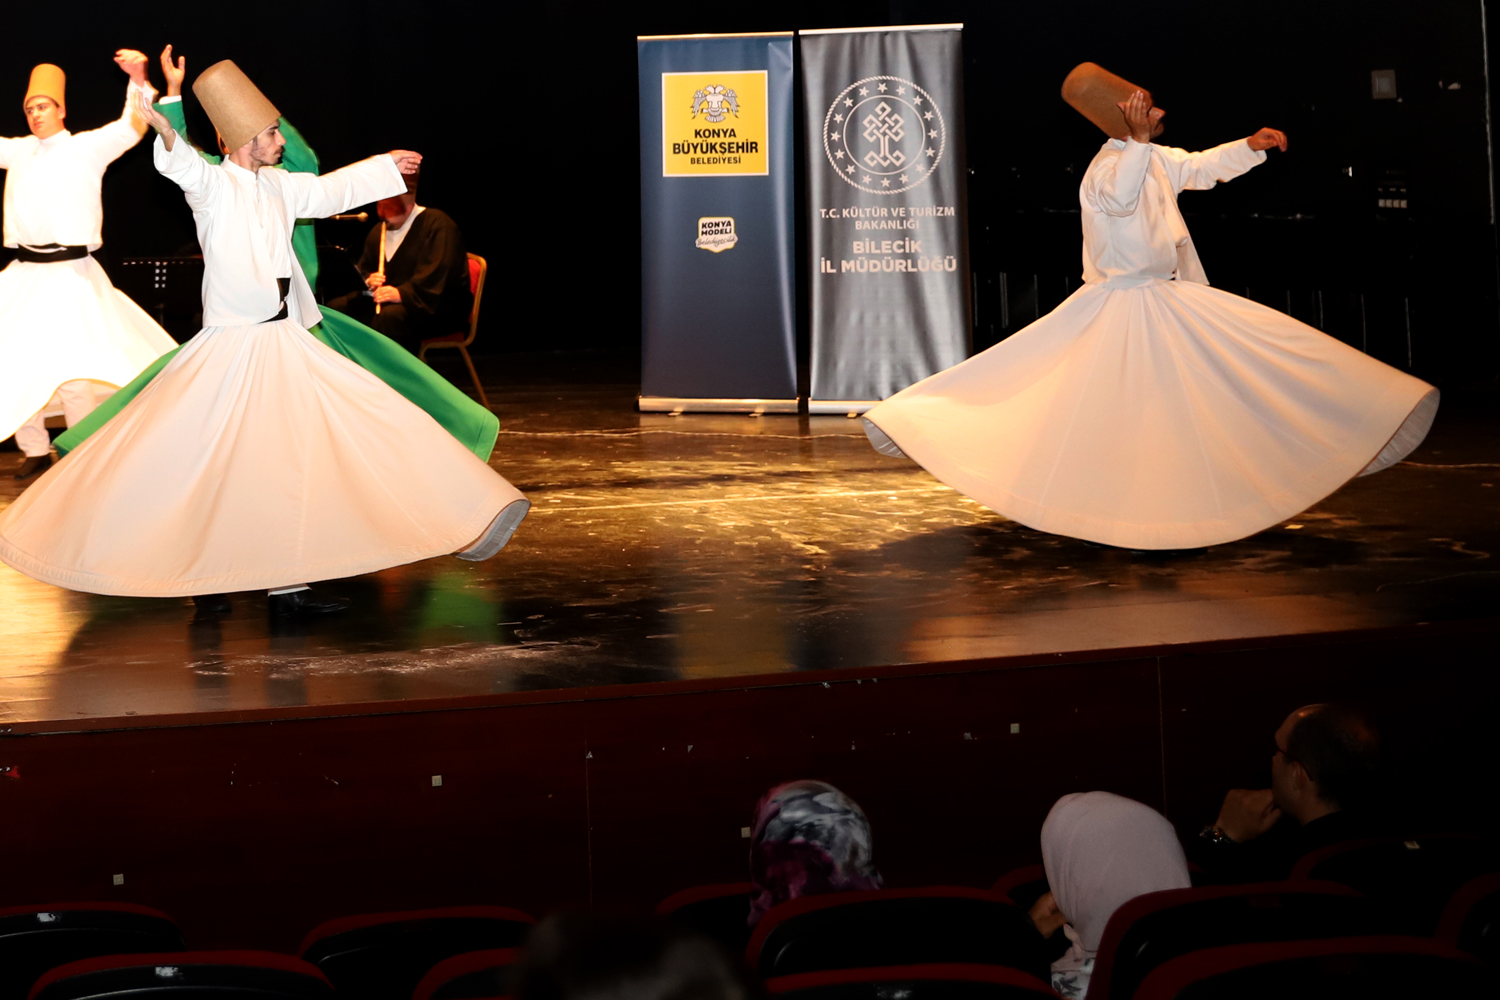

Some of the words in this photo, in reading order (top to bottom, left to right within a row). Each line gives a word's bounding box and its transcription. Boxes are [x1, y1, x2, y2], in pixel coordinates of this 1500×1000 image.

[694, 128, 737, 138] KONYA
[672, 139, 759, 155] BÜYÜKŞEHİR
[690, 155, 742, 165] BELEDİYESİ
[820, 208, 840, 218] T.C.
[842, 206, 888, 218] KÜLTÜR
[891, 207, 906, 216] VE
[909, 205, 955, 216] TURİZM
[701, 220, 732, 229] KONYA
[855, 218, 919, 230] BAKANLIĞI
[852, 237, 922, 254] BİLECİK
[820, 257, 836, 273] İL
[841, 256, 957, 273] MÜDÜRLÜĞÜ
